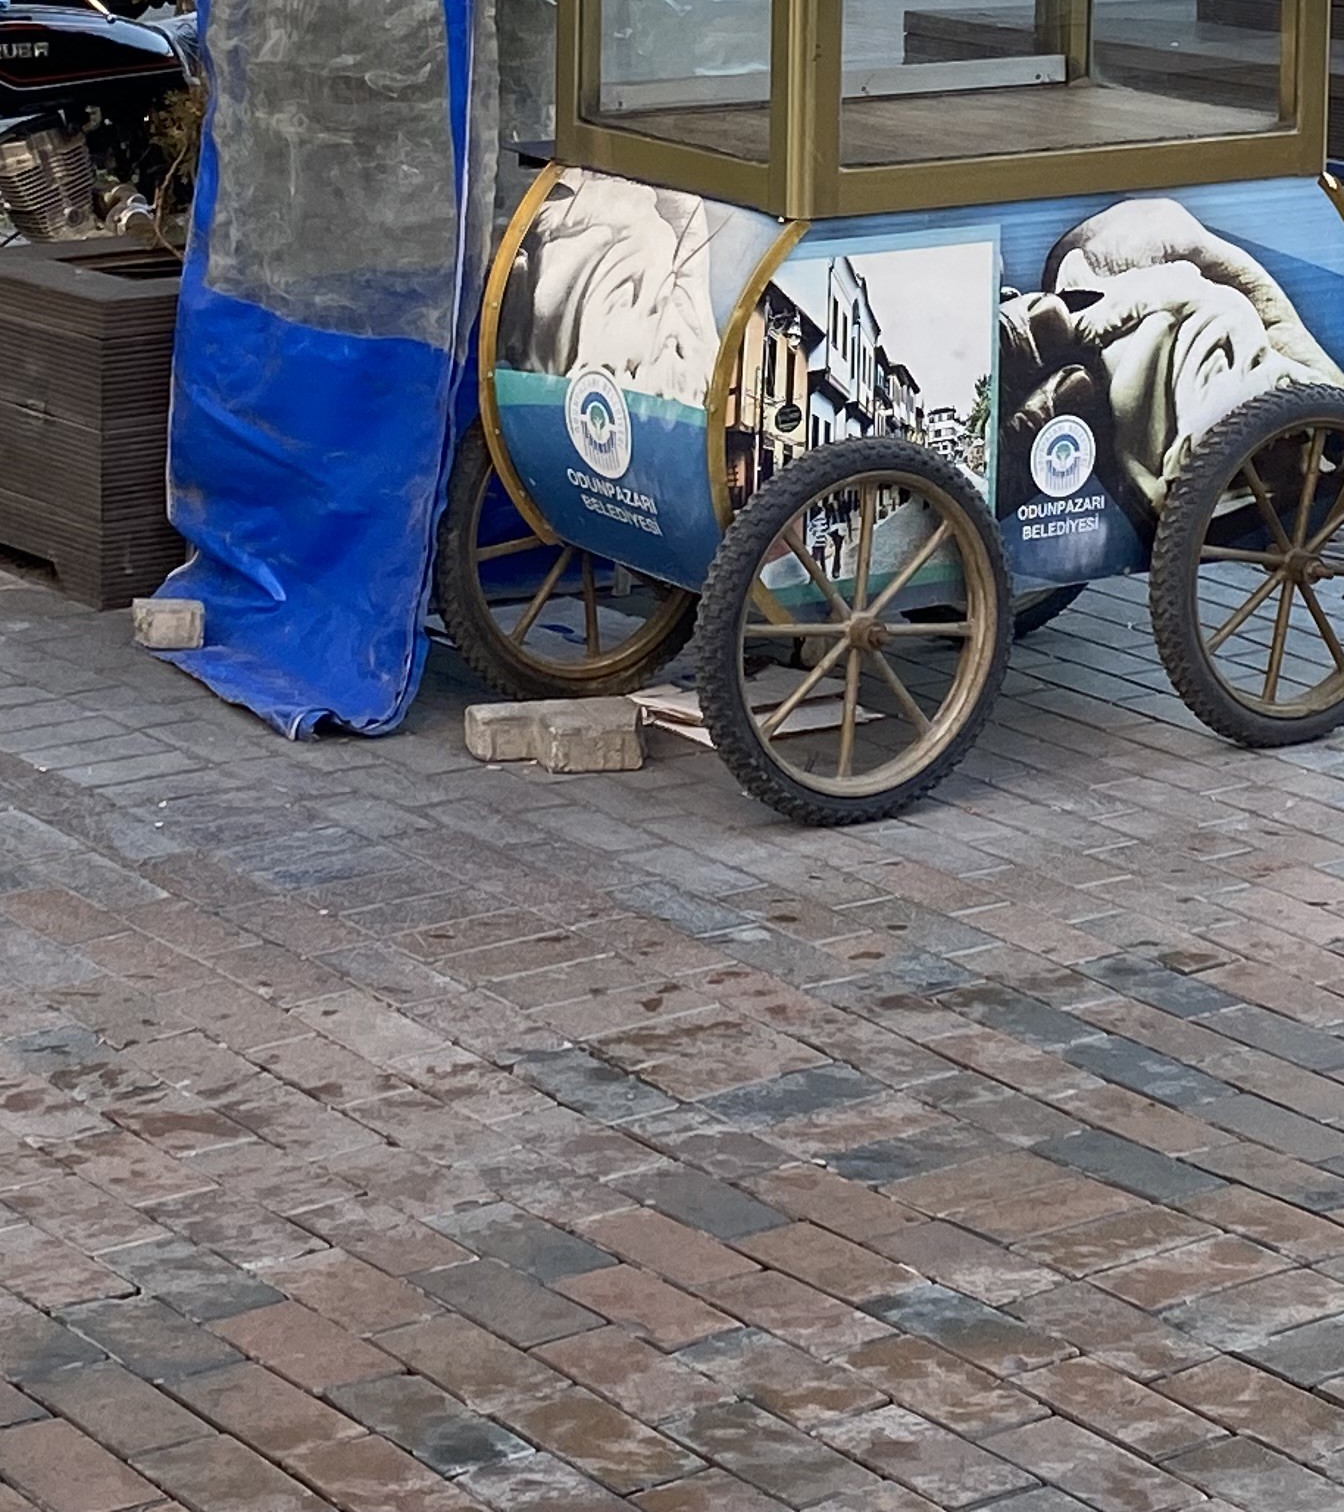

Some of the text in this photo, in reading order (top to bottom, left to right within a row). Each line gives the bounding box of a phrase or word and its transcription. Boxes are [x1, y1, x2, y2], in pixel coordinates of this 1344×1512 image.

[567, 468, 658, 515] ODUNPAZARI
[1017, 495, 1106, 521] ODUNPAZARI
[1022, 512, 1100, 541] BELEDİYESİ
